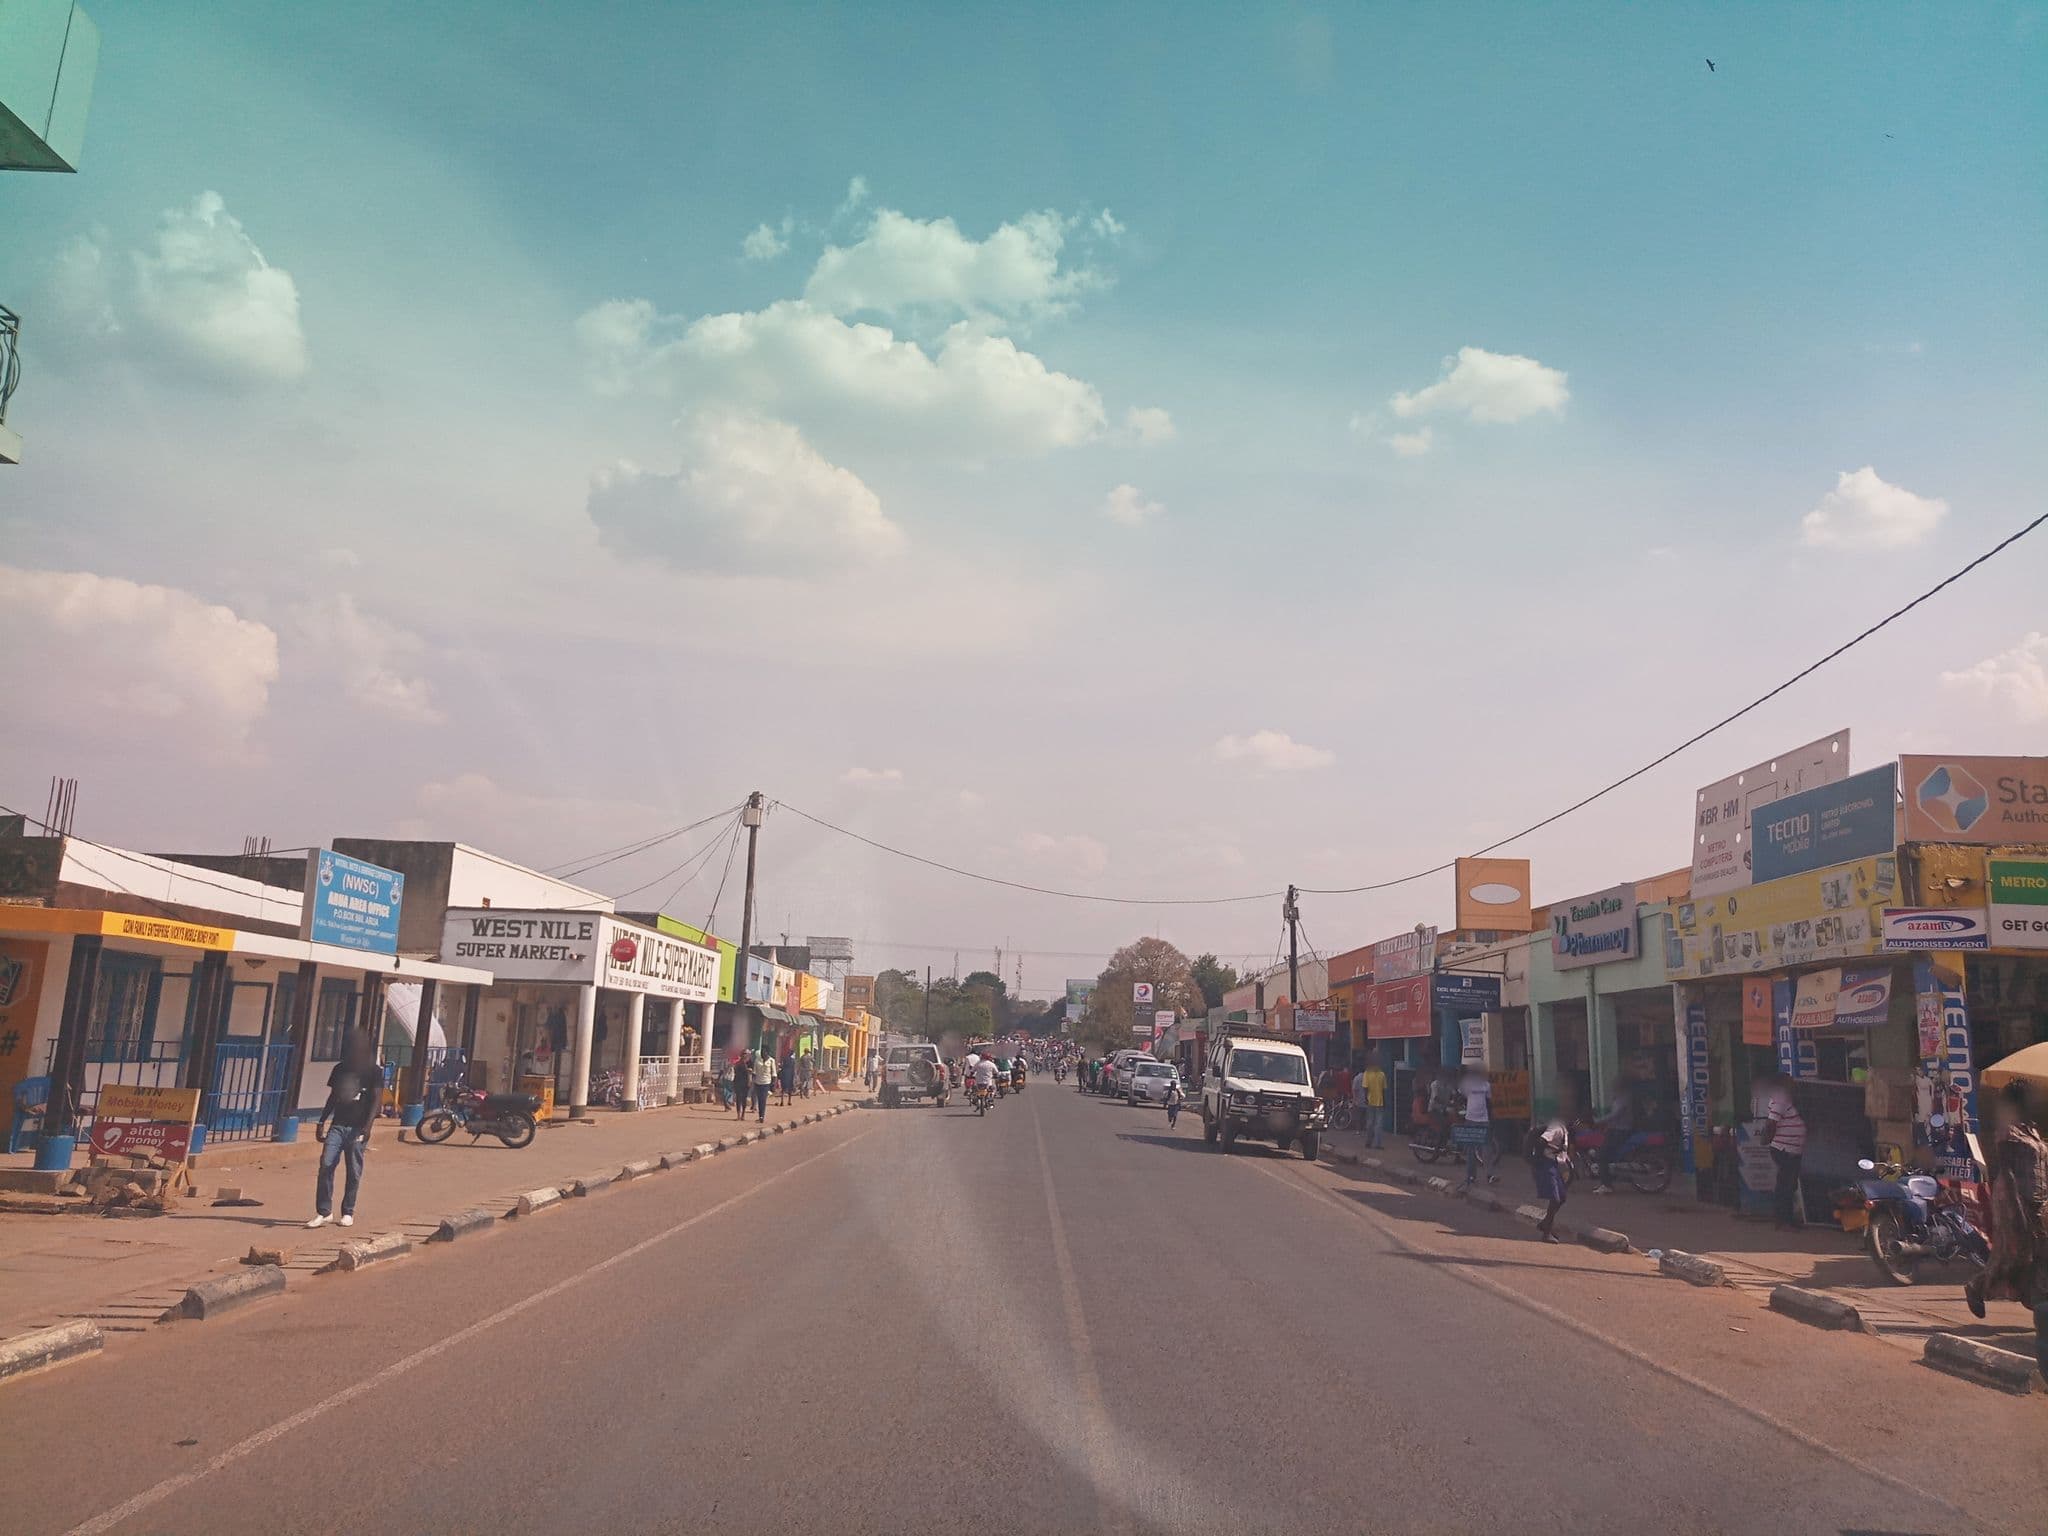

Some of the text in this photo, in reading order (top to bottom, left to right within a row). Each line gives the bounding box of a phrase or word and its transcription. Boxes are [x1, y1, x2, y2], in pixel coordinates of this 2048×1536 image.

[342, 873, 379, 899] (NWSC)
[2001, 876, 2046, 889] METRO
[367, 901, 390, 918] OFFICE
[472, 918, 594, 940] WEST NILE
[1907, 920, 1953, 931] azamtv
[2002, 919, 2029, 932] GET
[456, 942, 570, 961] SUPER MARKET
[1887, 938, 1985, 948] AUTHORISED AGENT
[640, 936, 663, 978] NILE
[1778, 1005, 1793, 1077] TECN
[1942, 985, 1973, 1094] TECNO
[133, 1087, 164, 1097] MTN
[107, 1096, 185, 1113] Mobile Money
[129, 1125, 166, 1137] airtel
[123, 1136, 165, 1148] money
